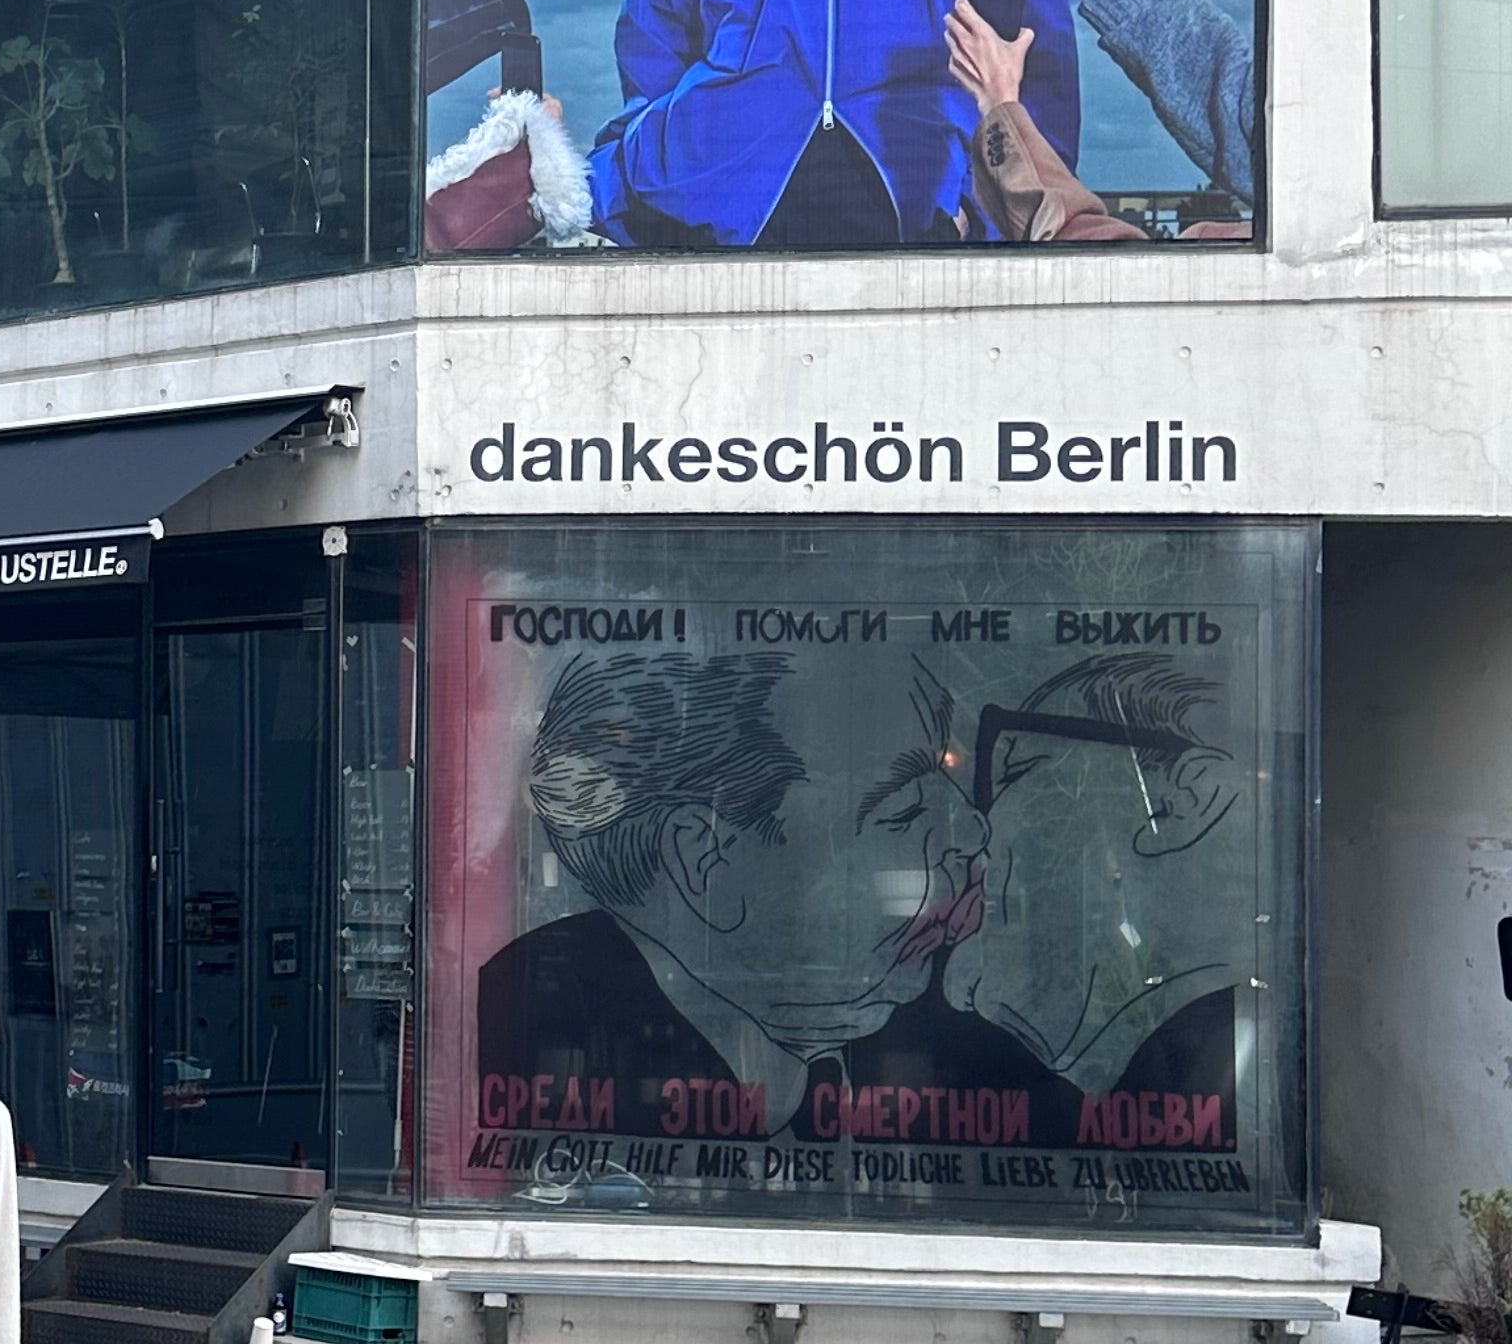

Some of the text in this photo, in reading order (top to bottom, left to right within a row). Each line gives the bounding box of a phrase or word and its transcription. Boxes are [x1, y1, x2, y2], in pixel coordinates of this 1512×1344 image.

[469, 421, 1239, 484] dankeschön Berlin
[931, 610, 1012, 642] МНЕ
[1055, 610, 1223, 644] ВЫЖИТЬ
[482, 1072, 616, 1129] СРЕДИ
